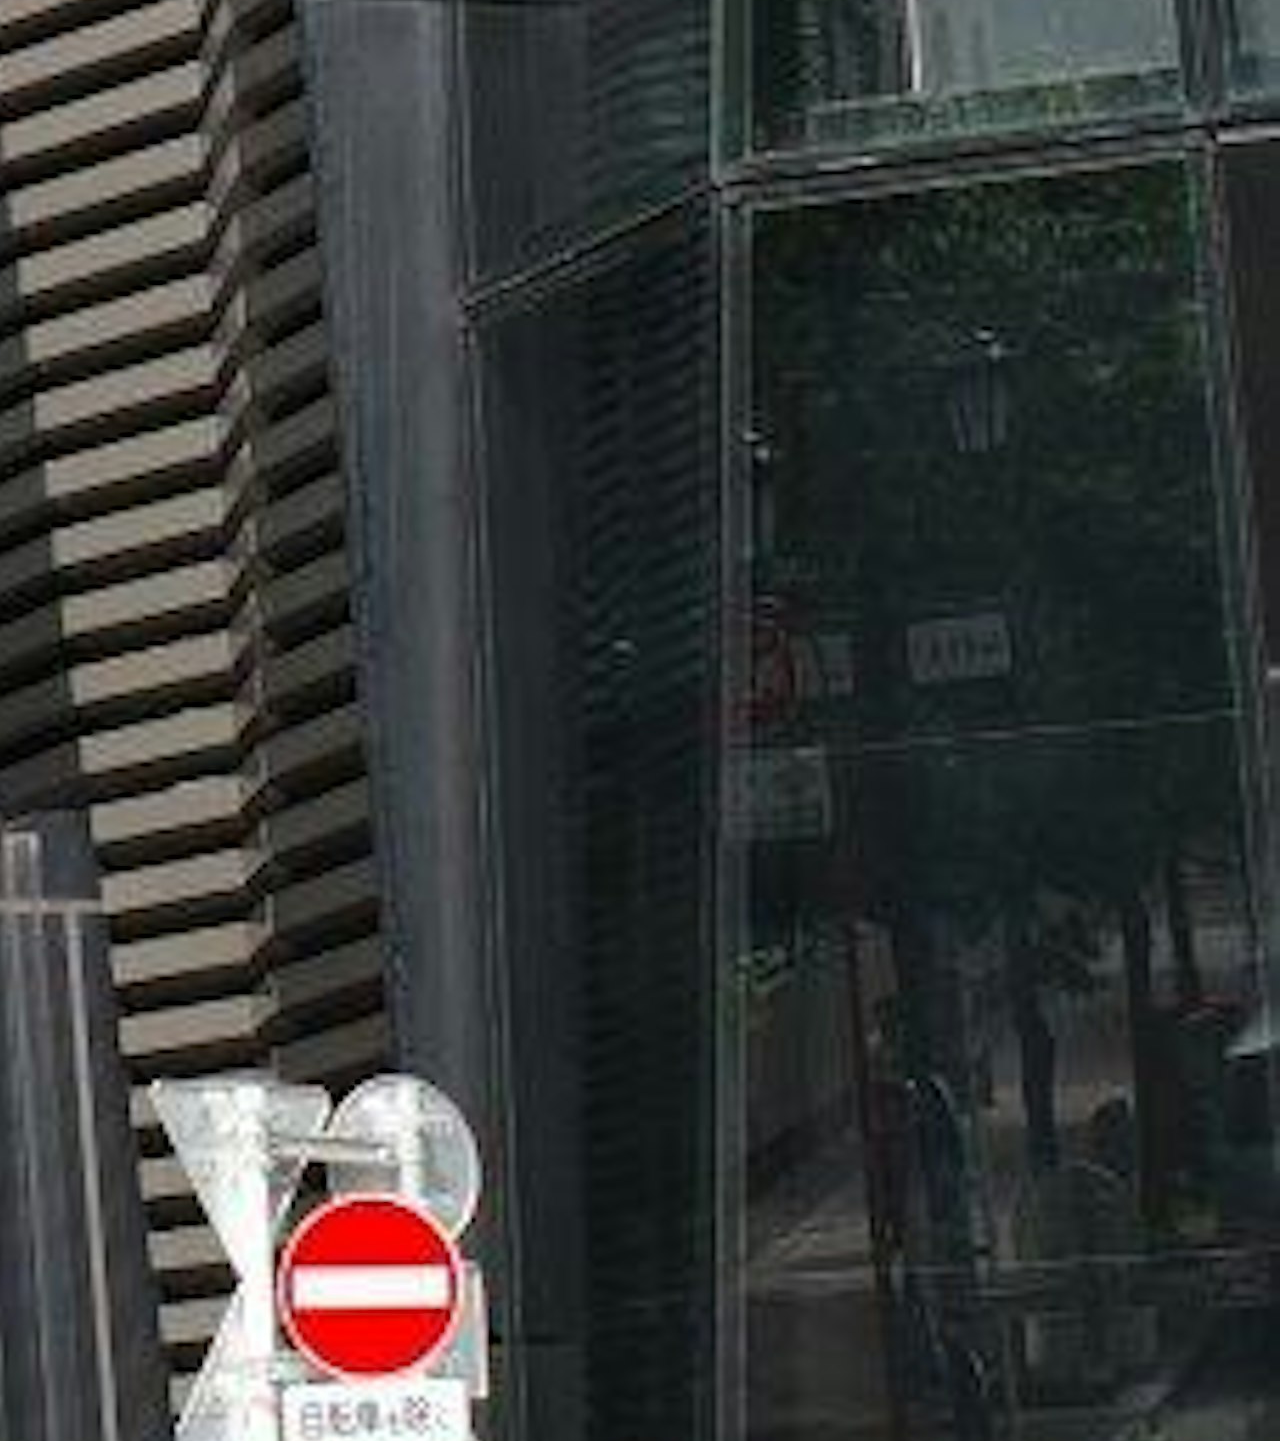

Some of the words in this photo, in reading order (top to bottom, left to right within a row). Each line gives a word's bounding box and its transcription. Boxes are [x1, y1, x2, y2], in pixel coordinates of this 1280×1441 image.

[301, 1396, 450, 1441] 自転車を除く
